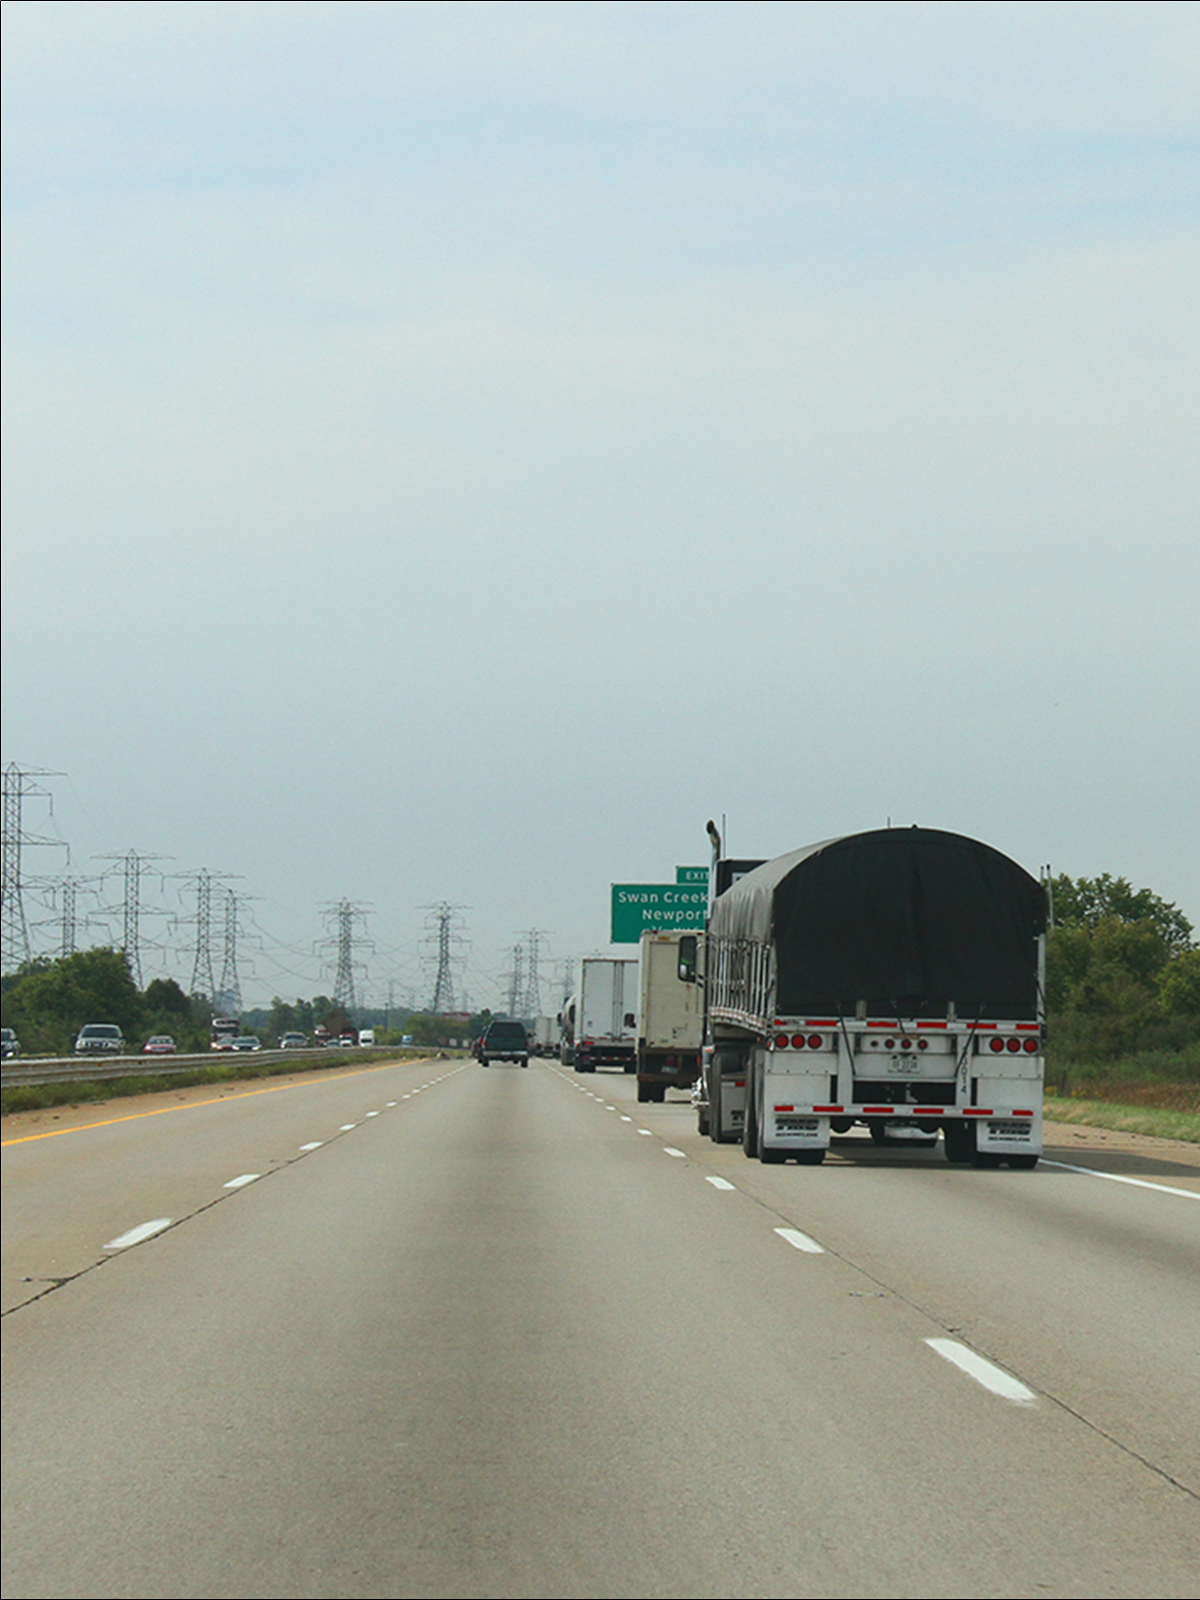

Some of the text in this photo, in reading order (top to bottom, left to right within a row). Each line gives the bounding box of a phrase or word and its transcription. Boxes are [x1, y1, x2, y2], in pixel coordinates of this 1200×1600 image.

[686, 871, 709, 880] EXIT
[618, 891, 708, 903] Swan Creek
[642, 909, 708, 923] Newport
